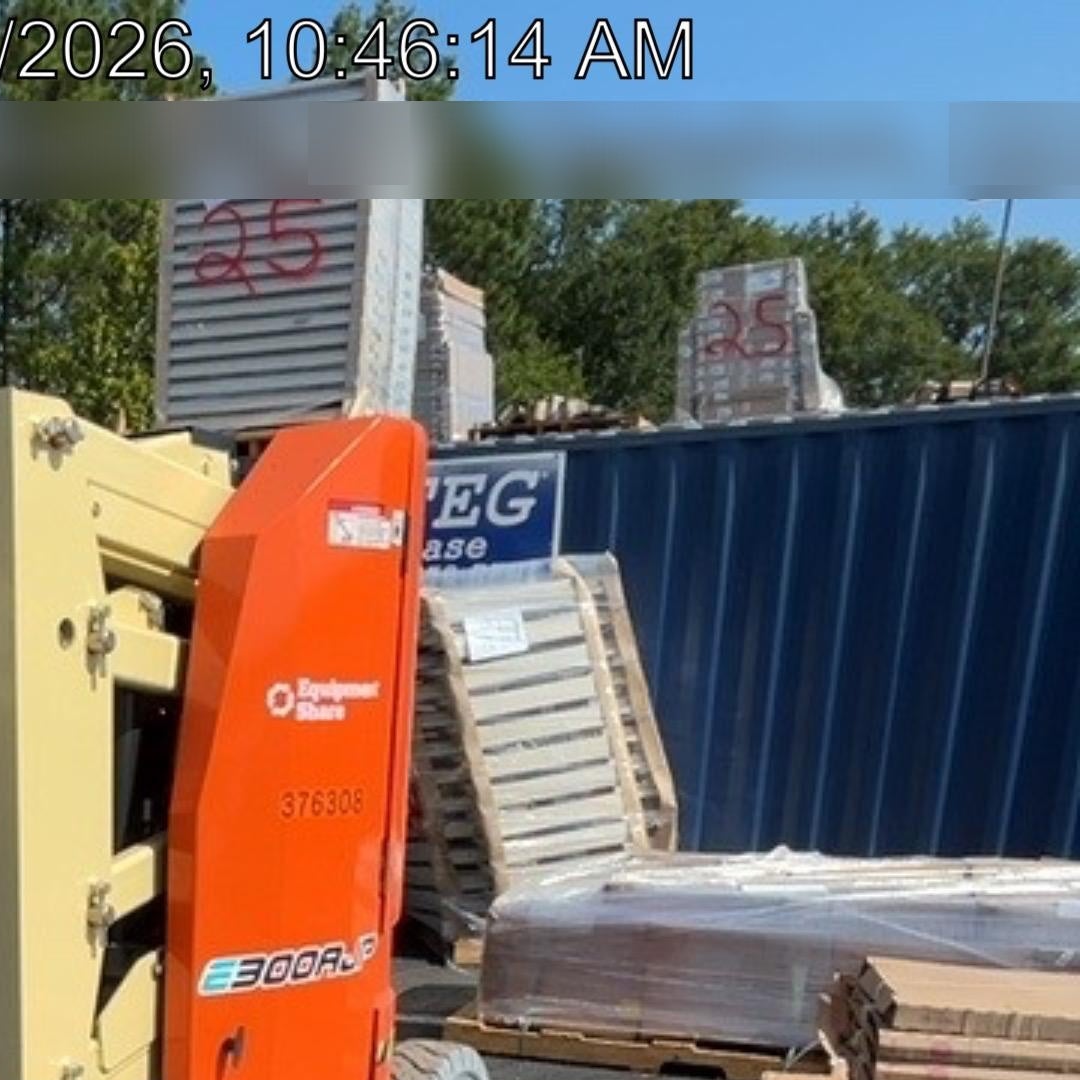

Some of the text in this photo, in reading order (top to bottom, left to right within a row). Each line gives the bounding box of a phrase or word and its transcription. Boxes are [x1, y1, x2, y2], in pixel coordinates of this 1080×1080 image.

[194, 200, 323, 297] 25
[704, 289, 791, 358] 25
[423, 536, 488, 562] ase
[280, 788, 364, 818] 376308
